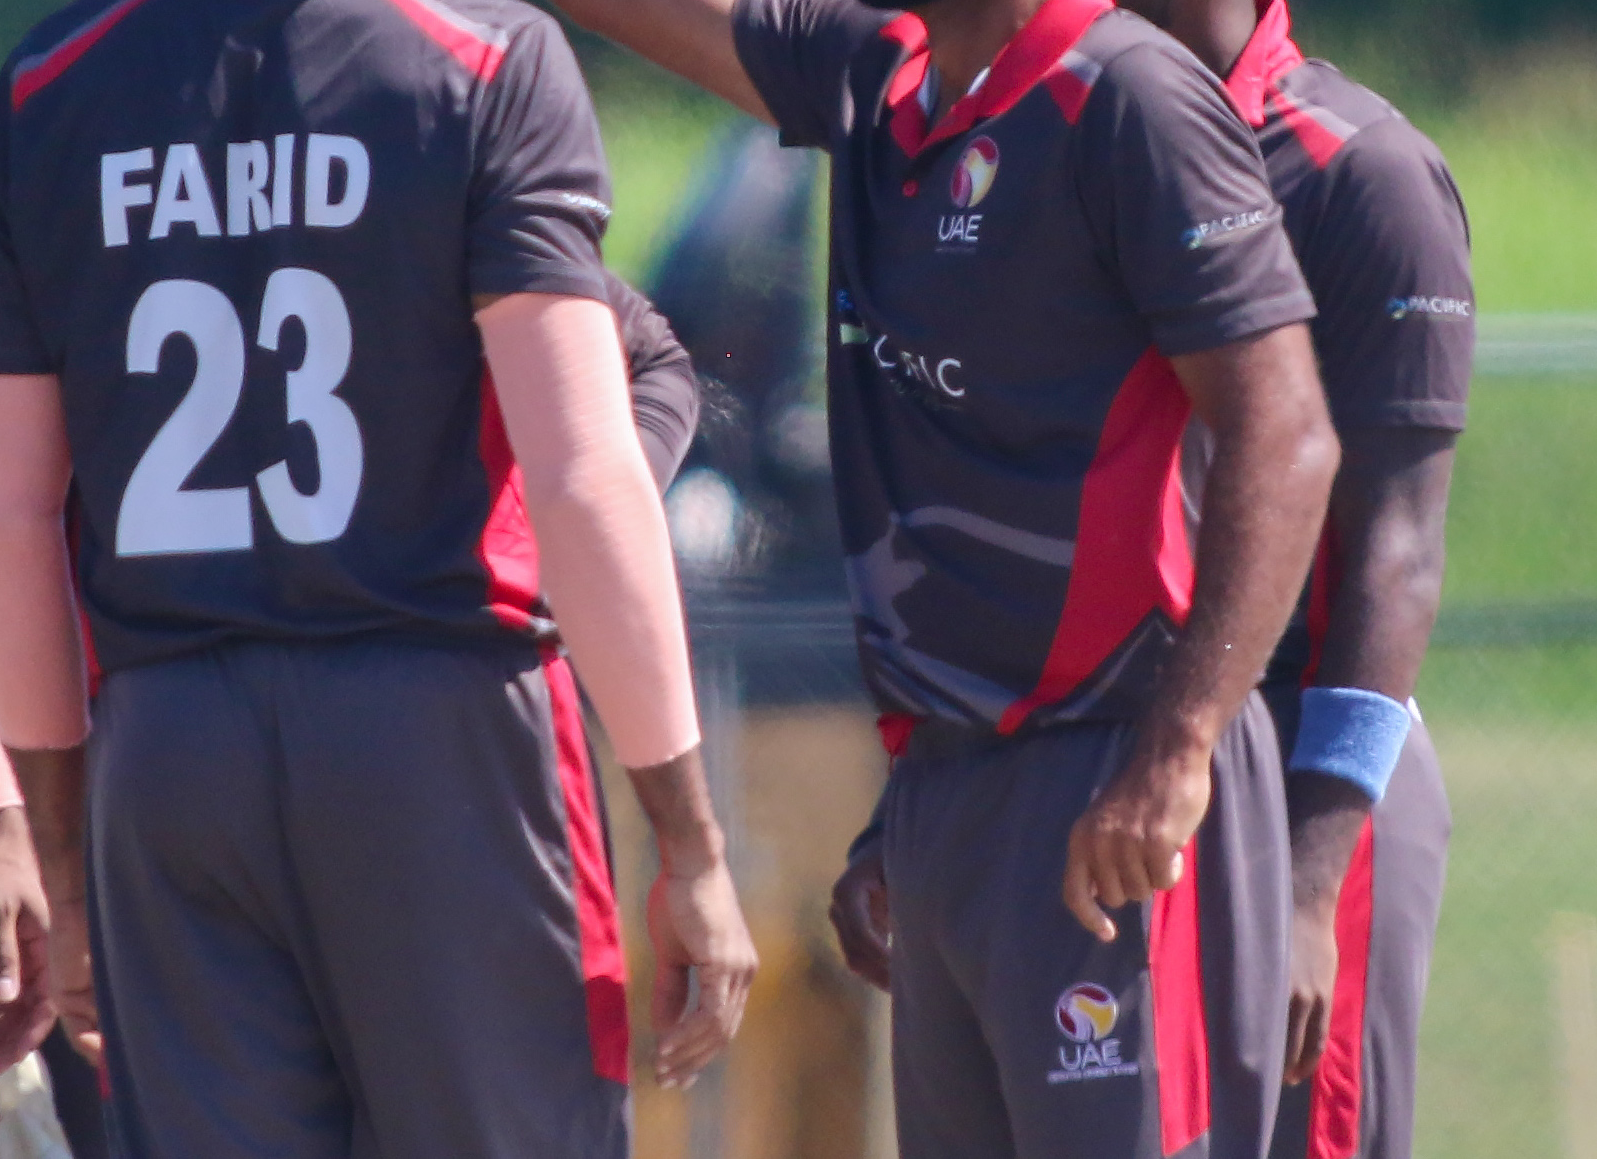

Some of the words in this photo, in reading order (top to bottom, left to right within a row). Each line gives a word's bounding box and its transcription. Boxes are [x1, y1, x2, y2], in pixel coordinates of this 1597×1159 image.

[100, 133, 371, 248] FARID
[938, 214, 983, 242] UAE
[115, 267, 363, 557] 23
[1059, 1037, 1122, 1072] UAE
